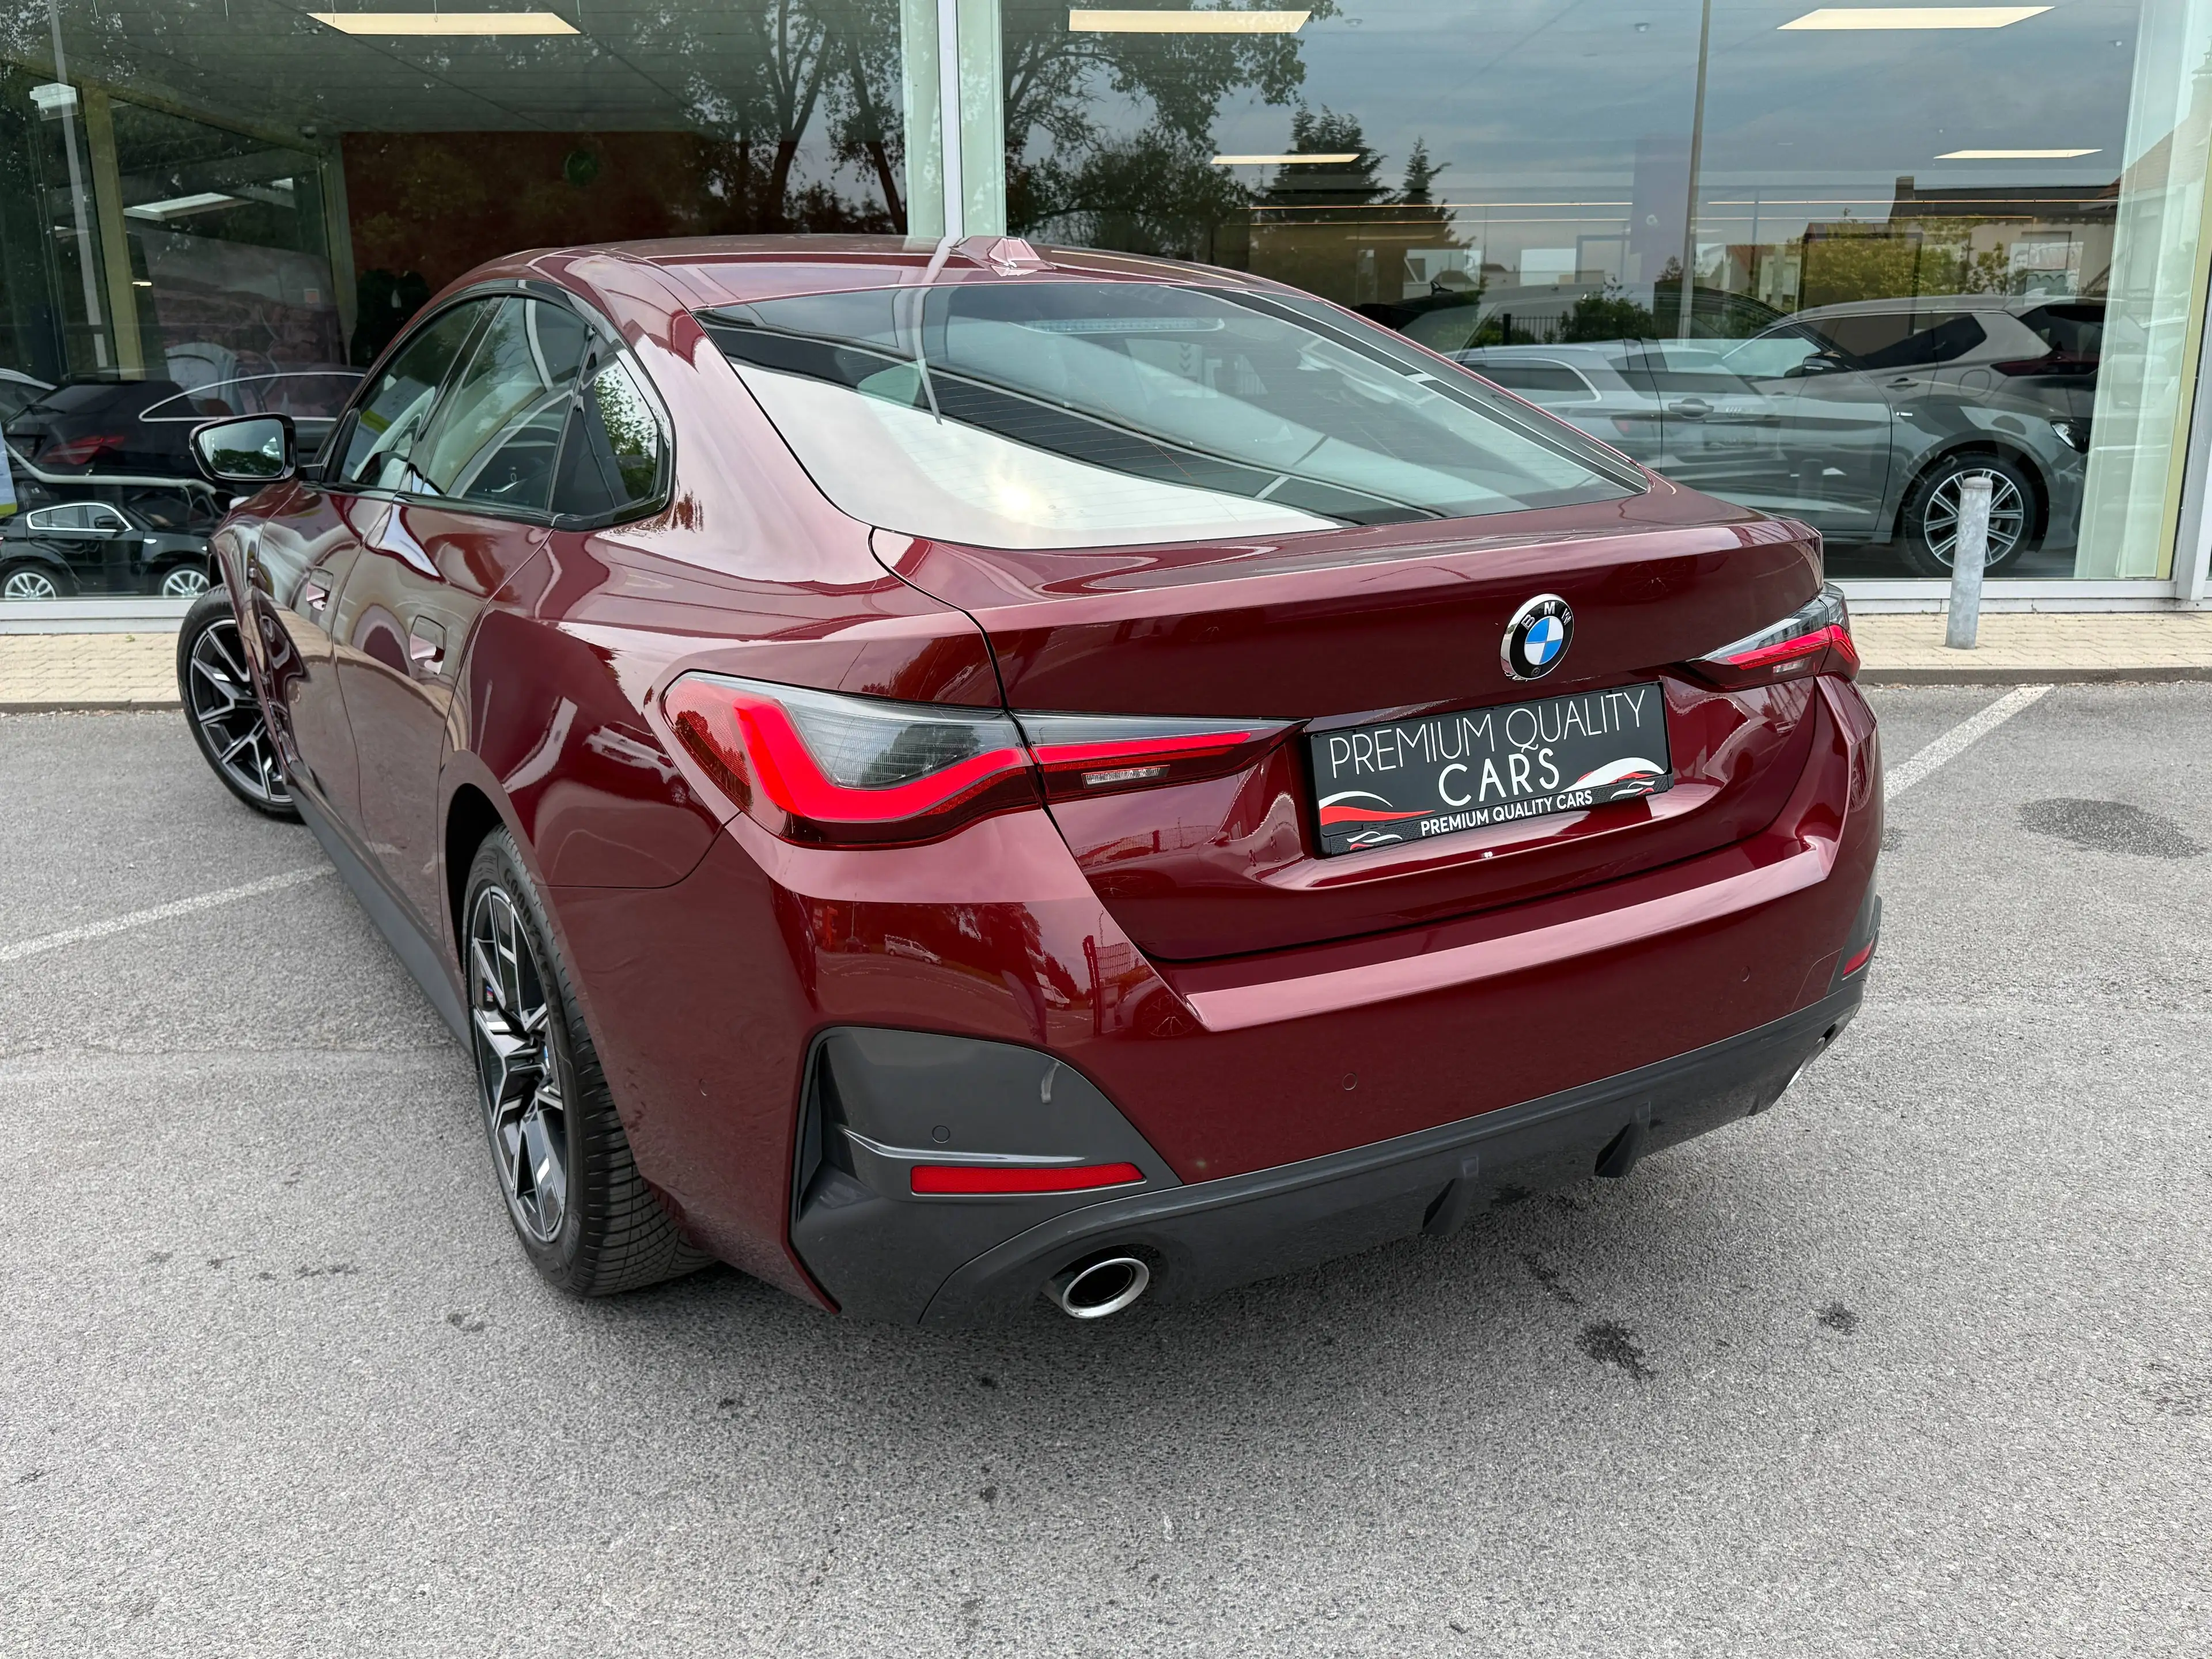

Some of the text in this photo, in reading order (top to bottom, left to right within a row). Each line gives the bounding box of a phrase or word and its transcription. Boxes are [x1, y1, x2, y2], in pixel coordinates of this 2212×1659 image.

[1521, 601, 1572, 631] BMW
[1330, 689, 1645, 778] PREMIUM QUALITY
[1438, 748, 1559, 806] CARS
[1421, 790, 1593, 836] PREMIUM QUALITY CARS
